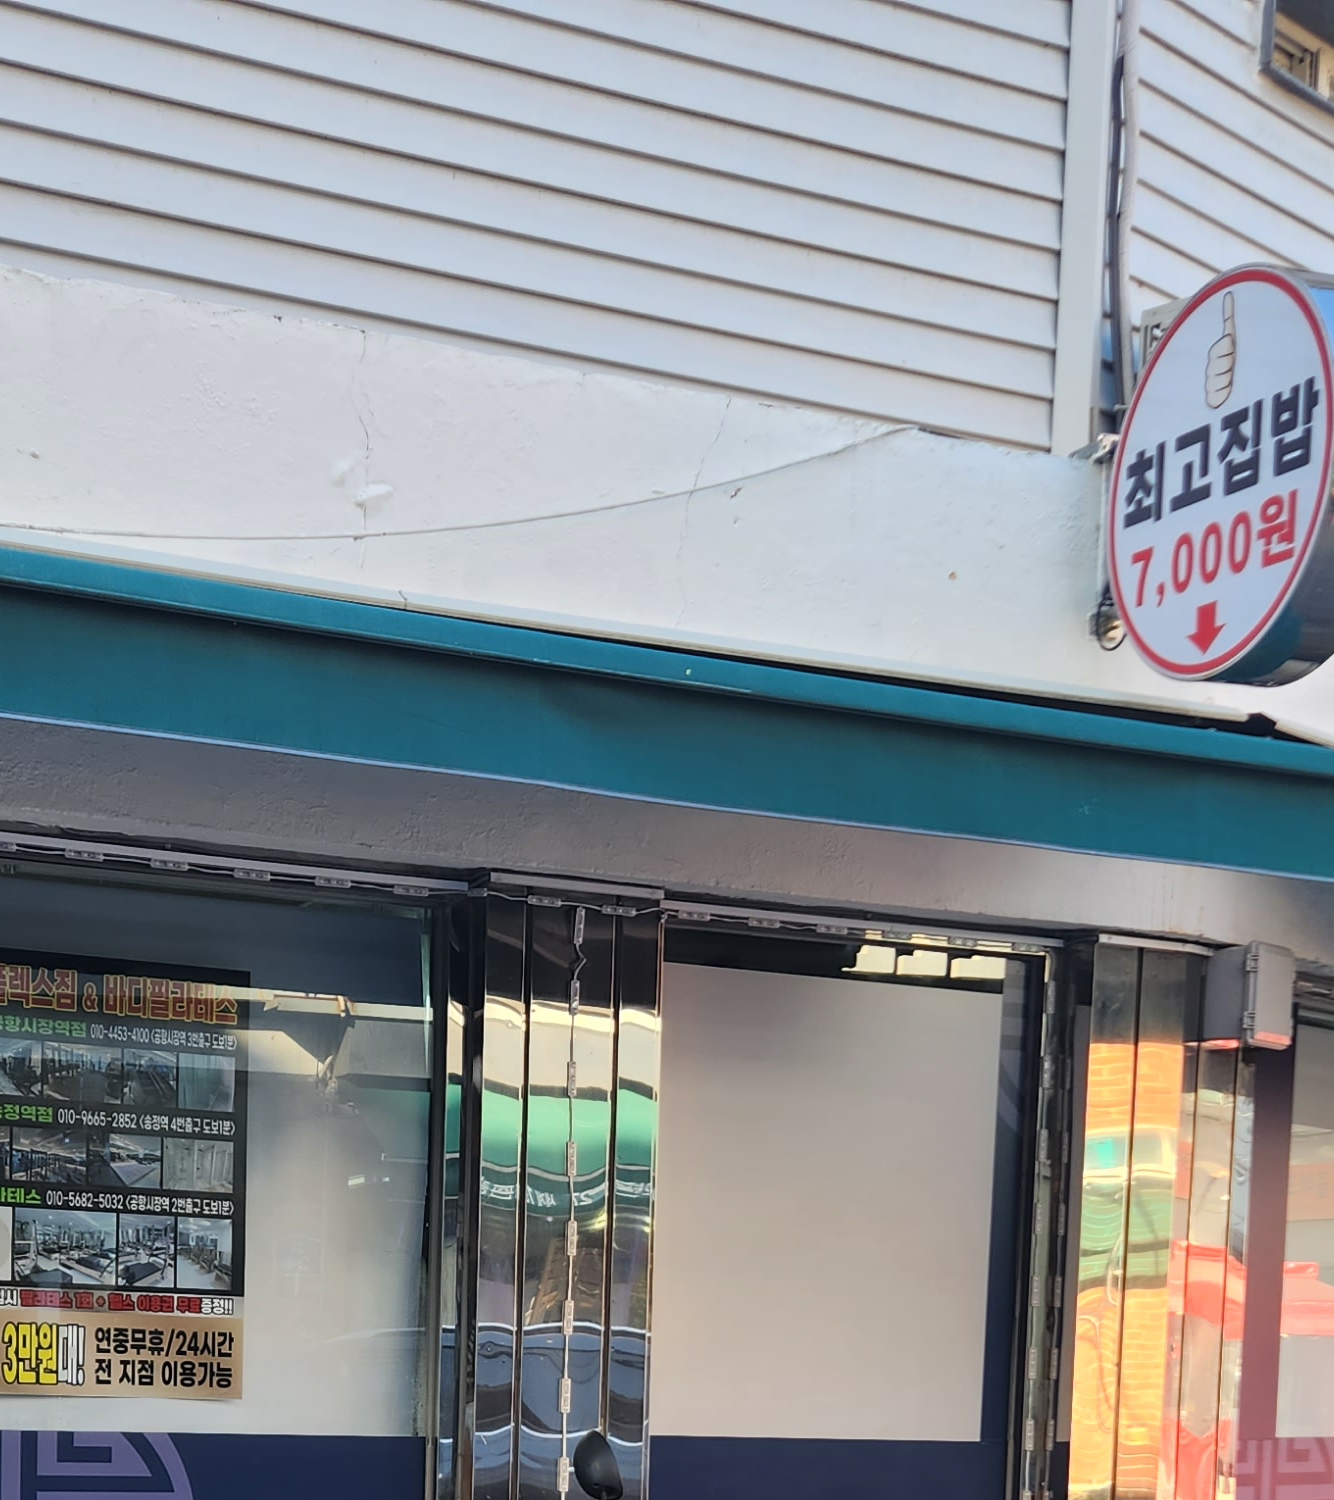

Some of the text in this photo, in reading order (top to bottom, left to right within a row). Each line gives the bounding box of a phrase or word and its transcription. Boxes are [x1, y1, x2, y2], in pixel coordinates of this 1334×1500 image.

[1123, 376, 1320, 530] 최고집밥
[1131, 488, 1299, 607] 7,000원
[83, 982, 98, 1012] &
[103, 973, 238, 1025] 바디필라테스
[90, 1024, 150, 1043] 010-4453-4100
[58, 1109, 137, 1129] 010-9665-2852
[46, 1191, 124, 1209] 010-5682-5032
[137, 1294, 174, 1312] 이용권
[2, 1321, 85, 1385] 3만원대!
[95, 1326, 234, 1358] 연중무휴/24시간
[95, 1358, 233, 1388] 전 지점 이용가능
